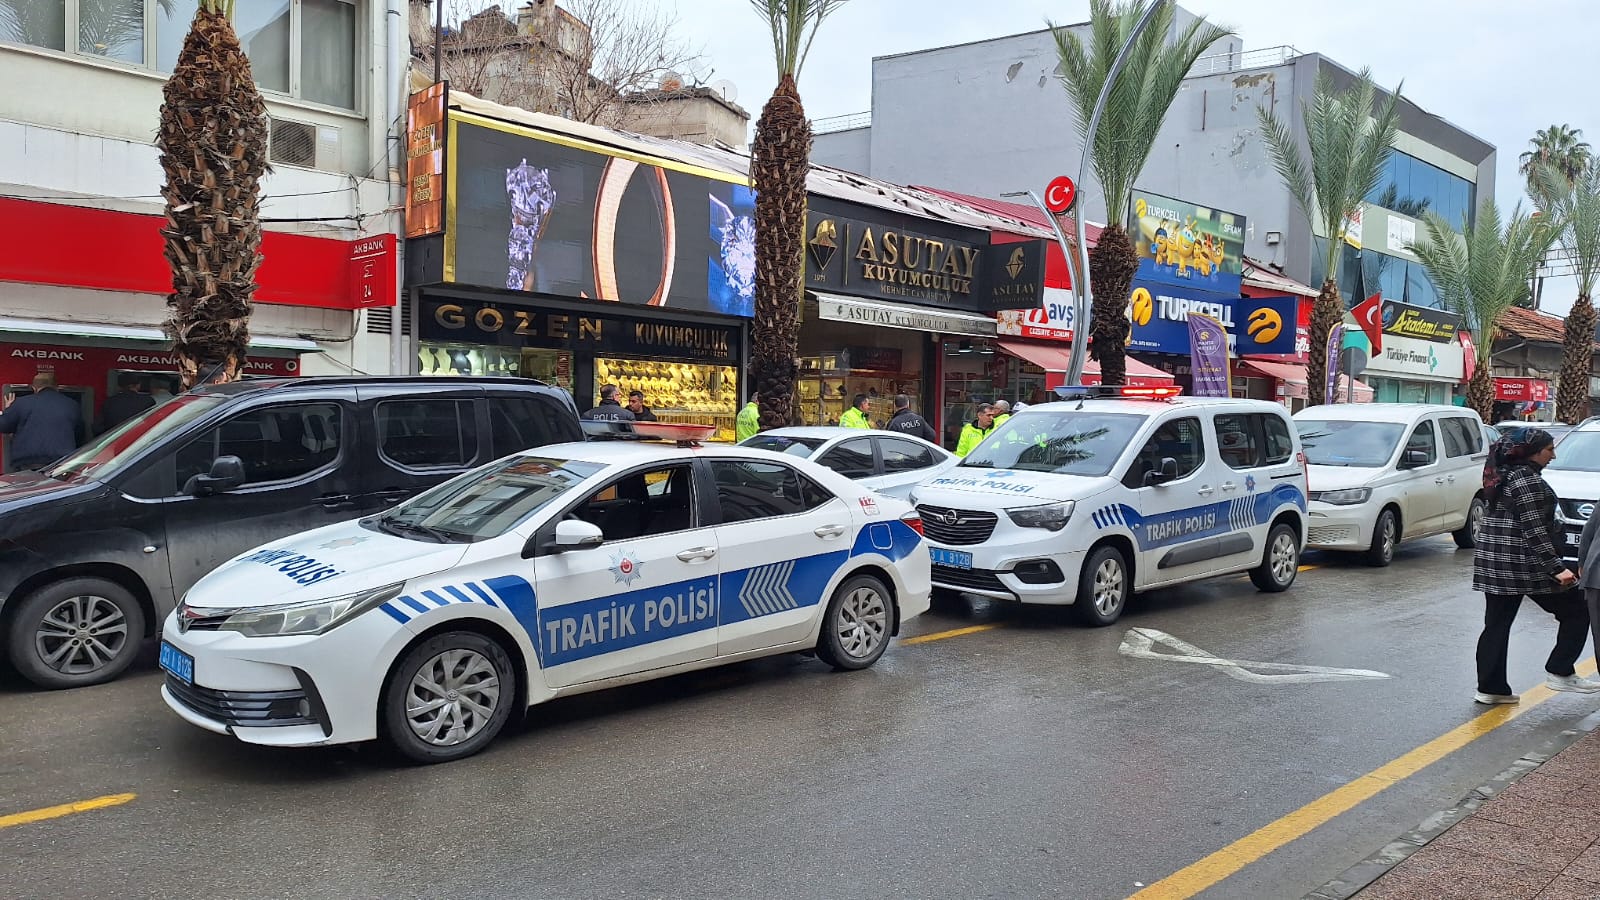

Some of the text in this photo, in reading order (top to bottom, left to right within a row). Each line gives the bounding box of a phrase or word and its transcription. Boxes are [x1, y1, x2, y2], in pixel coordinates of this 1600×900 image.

[1147, 205, 1181, 222] TURKCELL
[353, 240, 384, 254] AKBANK
[855, 227, 980, 278] ASUTAY
[863, 263, 971, 294] KUYUMCULUK
[992, 283, 1035, 296] ASUTAY
[434, 303, 602, 341] GÖZEN
[847, 307, 892, 323] ASUTAY
[635, 323, 729, 351] KUYUMCULUK
[11, 349, 84, 361] AKBANK
[117, 354, 181, 365] AKBANK
[1387, 347, 1427, 364] Türkiye Finans
[1146, 508, 1216, 542] TRAFİK POLİSİ
[270, 555, 346, 587] POLİSİ
[546, 581, 714, 654] TRAFİK POLİSİ
